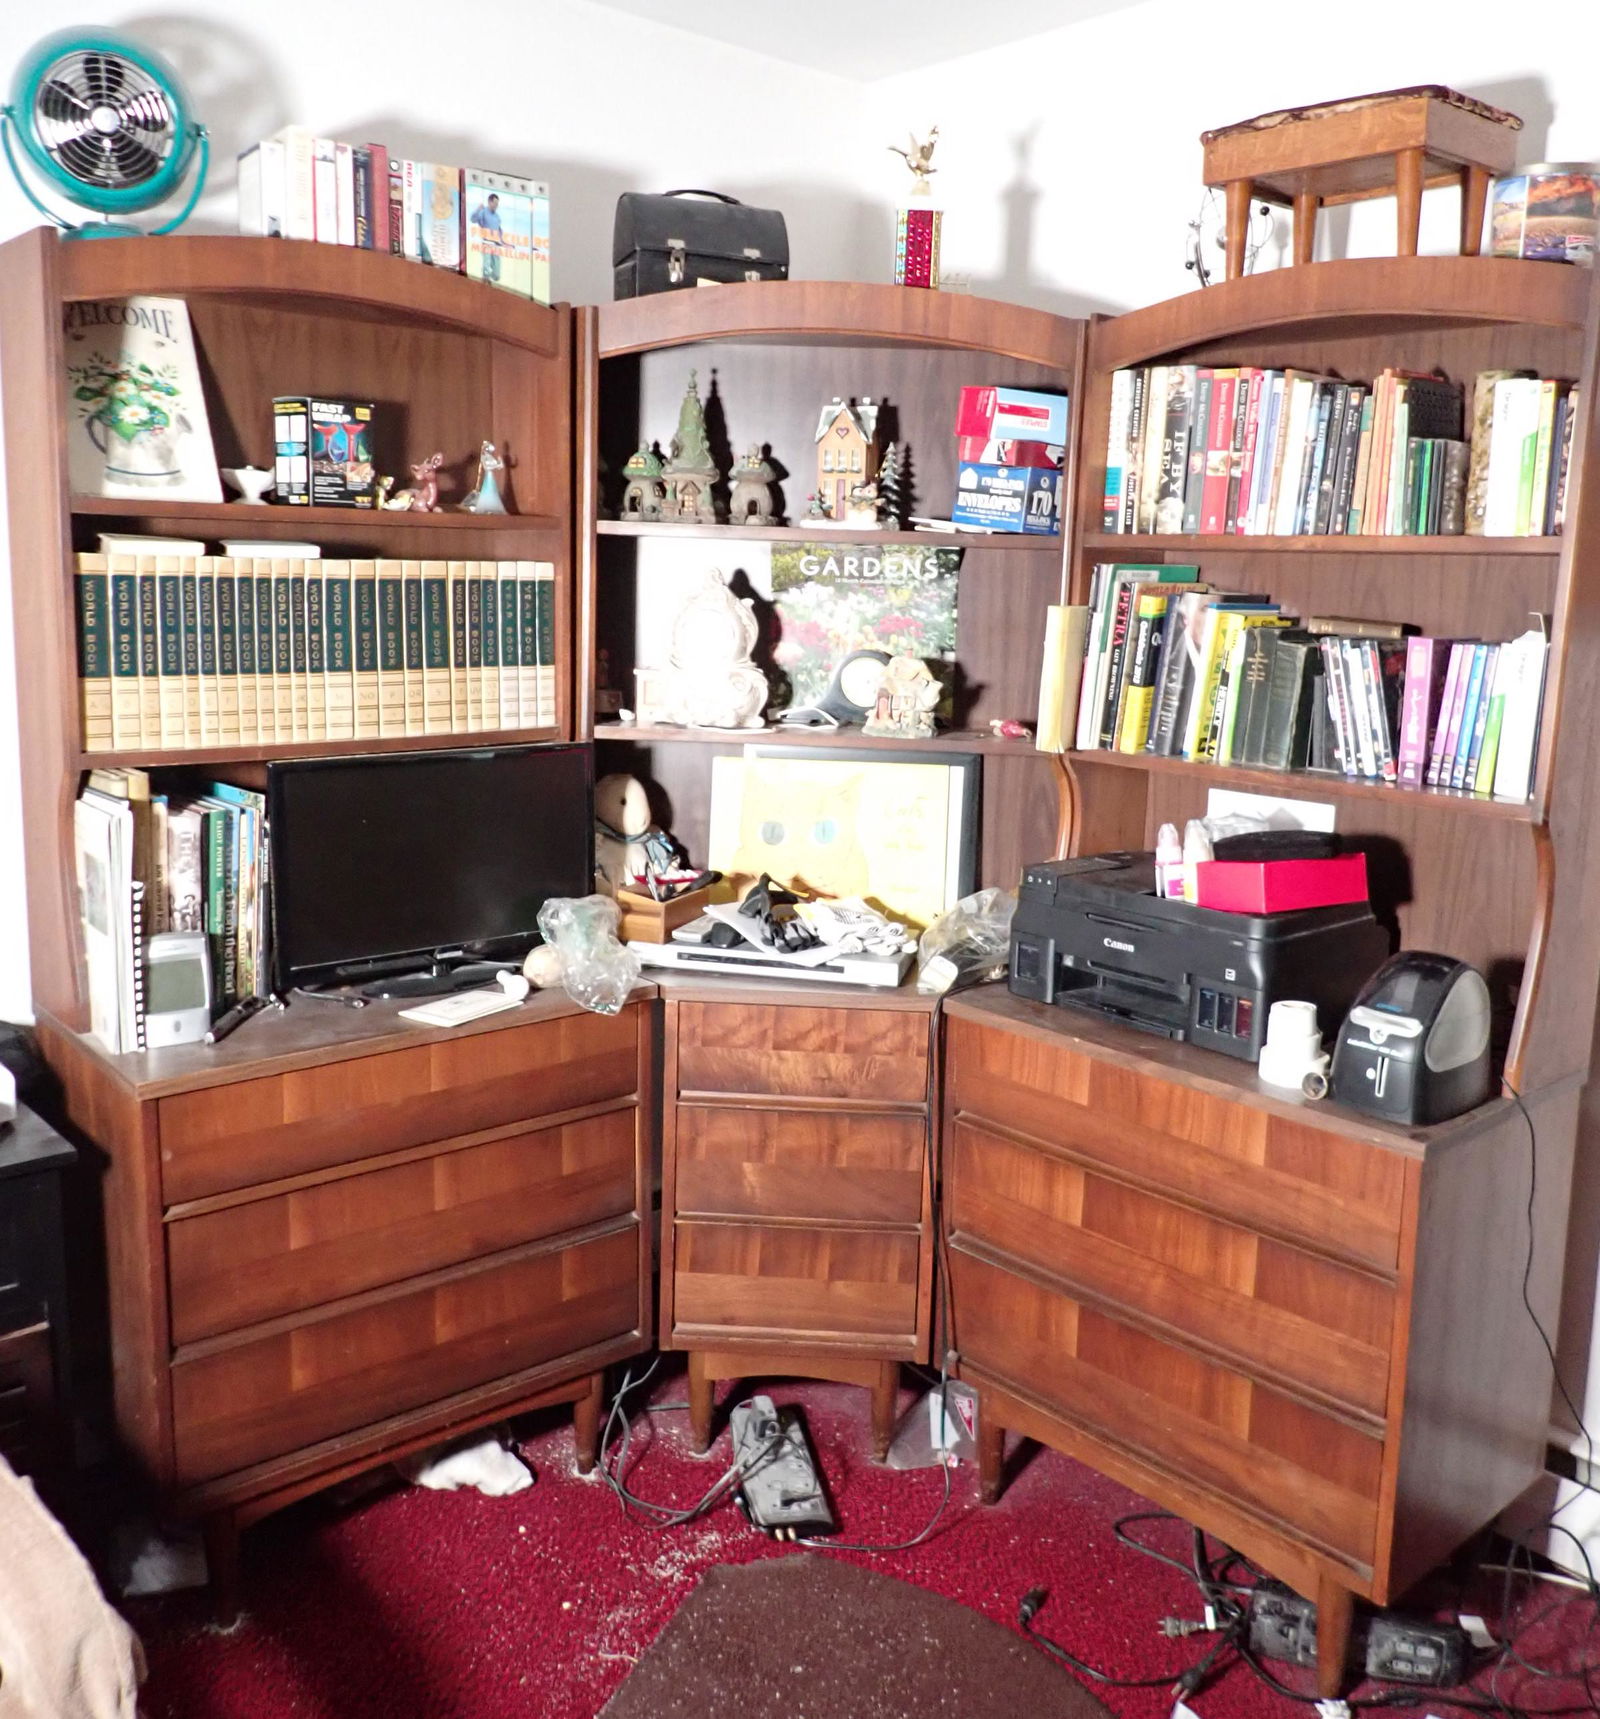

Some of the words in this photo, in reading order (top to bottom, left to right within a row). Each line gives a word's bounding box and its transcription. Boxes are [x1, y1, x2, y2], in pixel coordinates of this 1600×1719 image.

[311, 402, 344, 414] FAST
[1161, 438, 1173, 485] SEA
[1173, 430, 1186, 457] IF
[1169, 463, 1185, 499] BY
[1030, 490, 1053, 517] 170
[799, 555, 939, 580] GARDENS
[85, 581, 95, 626] WORLD
[119, 581, 129, 626] WORLD
[143, 581, 152, 626] WORLD
[165, 581, 175, 626] WORLD
[185, 581, 195, 626] WORLD
[201, 581, 211, 626] WORLD
[221, 582, 231, 627] WORLD
[241, 582, 250, 626] WORLD
[260, 582, 268, 626] WORLD
[278, 582, 286, 626] WORLD
[294, 582, 302, 626] WORLD
[310, 584, 319, 626] WORLD
[333, 583, 342, 626] WORLD
[361, 583, 369, 625] WORLD
[409, 583, 417, 624] WORLD
[431, 583, 439, 625] WORLD
[471, 583, 479, 623] WORLD
[505, 584, 513, 619] YEAR
[1113, 590, 1131, 646] PETRA
[87, 635, 96, 672] BOOK
[120, 634, 129, 672] BOOK
[145, 634, 153, 673] BOOK
[168, 634, 176, 671] BOOK
[187, 634, 196, 671] BOOK
[204, 634, 213, 671] BOOK
[224, 634, 232, 670] BOOK
[261, 634, 269, 669] BOOK
[279, 634, 287, 669] BOOK
[296, 633, 304, 669] BOOK
[312, 633, 320, 668] BOOK
[335, 633, 343, 668] BOOK
[388, 632, 396, 666] BOOK
[434, 631, 442, 664] BOOK
[456, 631, 464, 664] BOOK
[1135, 620, 1148, 664] QuickBooks
[1108, 665, 1119, 701] BROWNING
[216, 820, 224, 845] ELIOT
[215, 846, 224, 878] PORTER
[1103, 938, 1135, 952] Canon
[224, 958, 235, 995] Road
